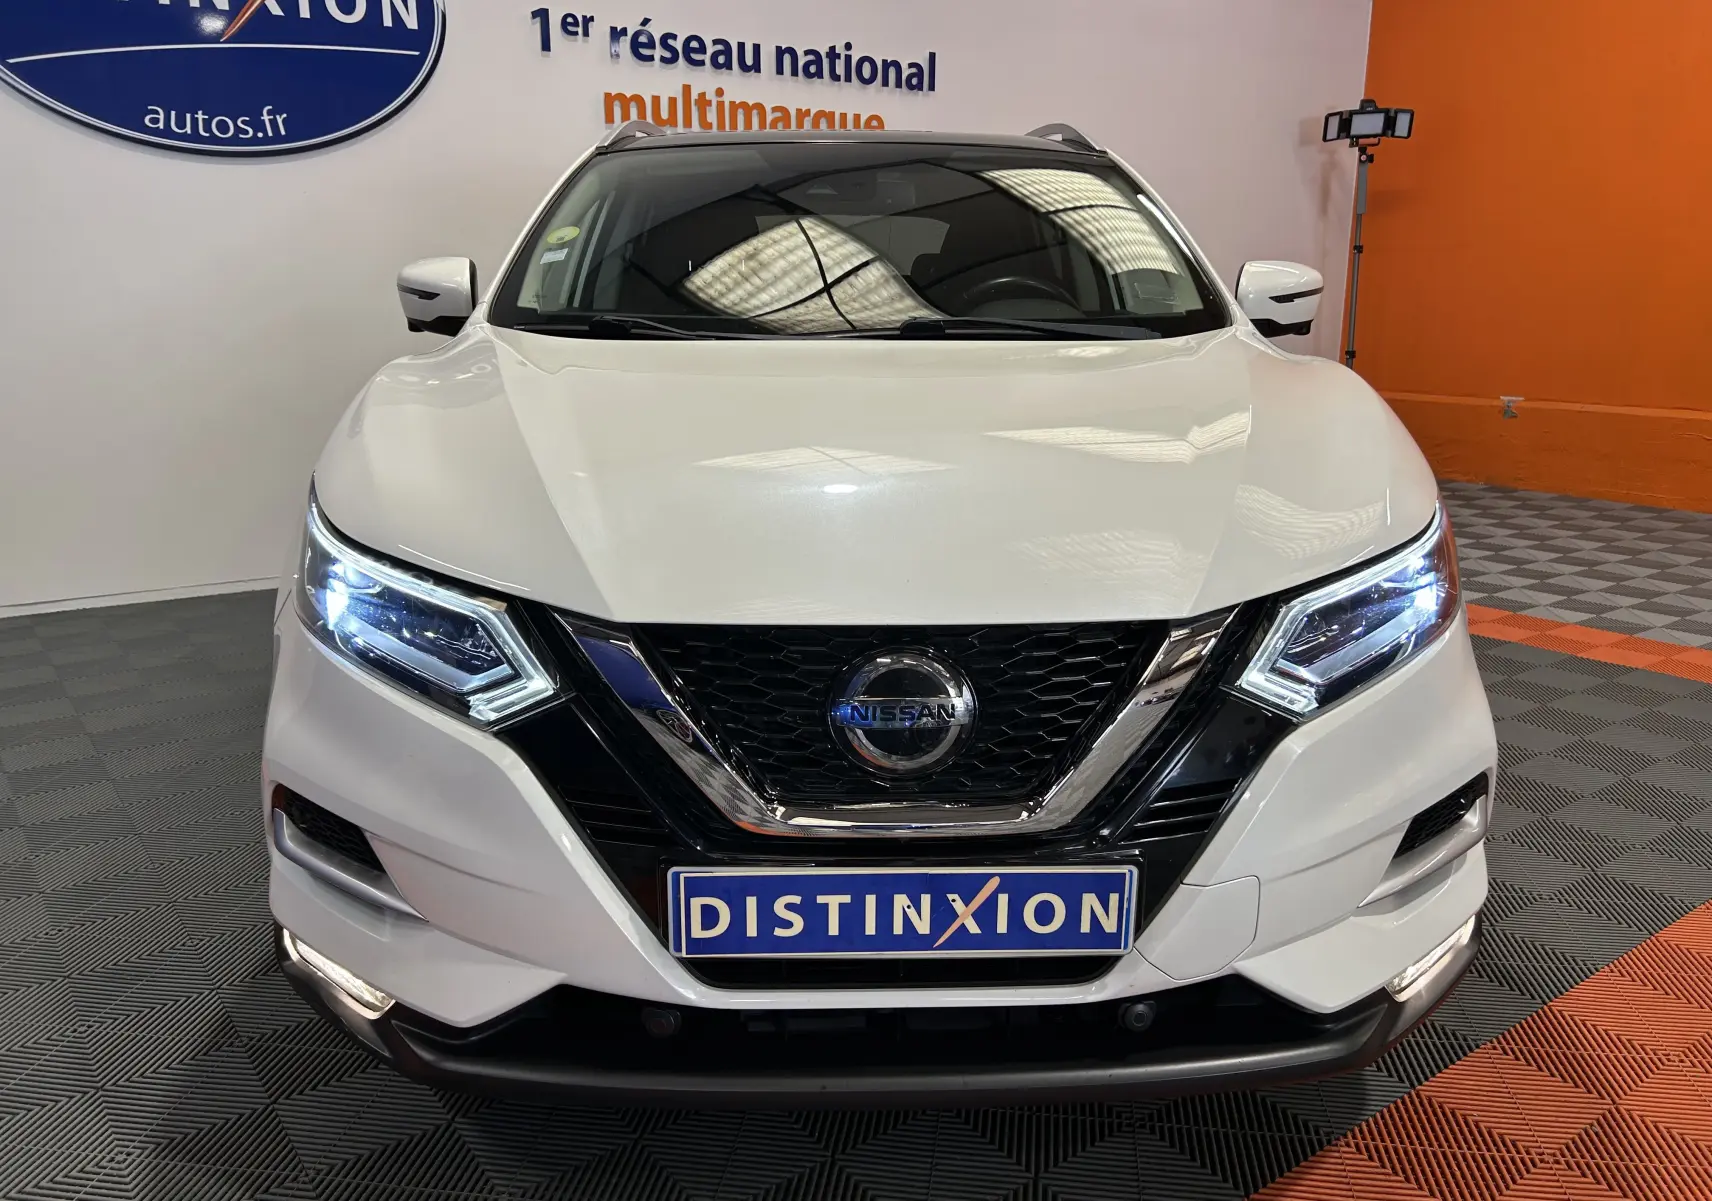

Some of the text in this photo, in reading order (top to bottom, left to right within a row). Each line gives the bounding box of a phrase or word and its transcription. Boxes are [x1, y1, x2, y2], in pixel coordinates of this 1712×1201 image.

[609, 17, 762, 74] réseau
[775, 41, 937, 92] national
[143, 105, 288, 139] autos.fr
[849, 703, 957, 722] NISSAN
[689, 876, 1120, 948] DISTINXION
